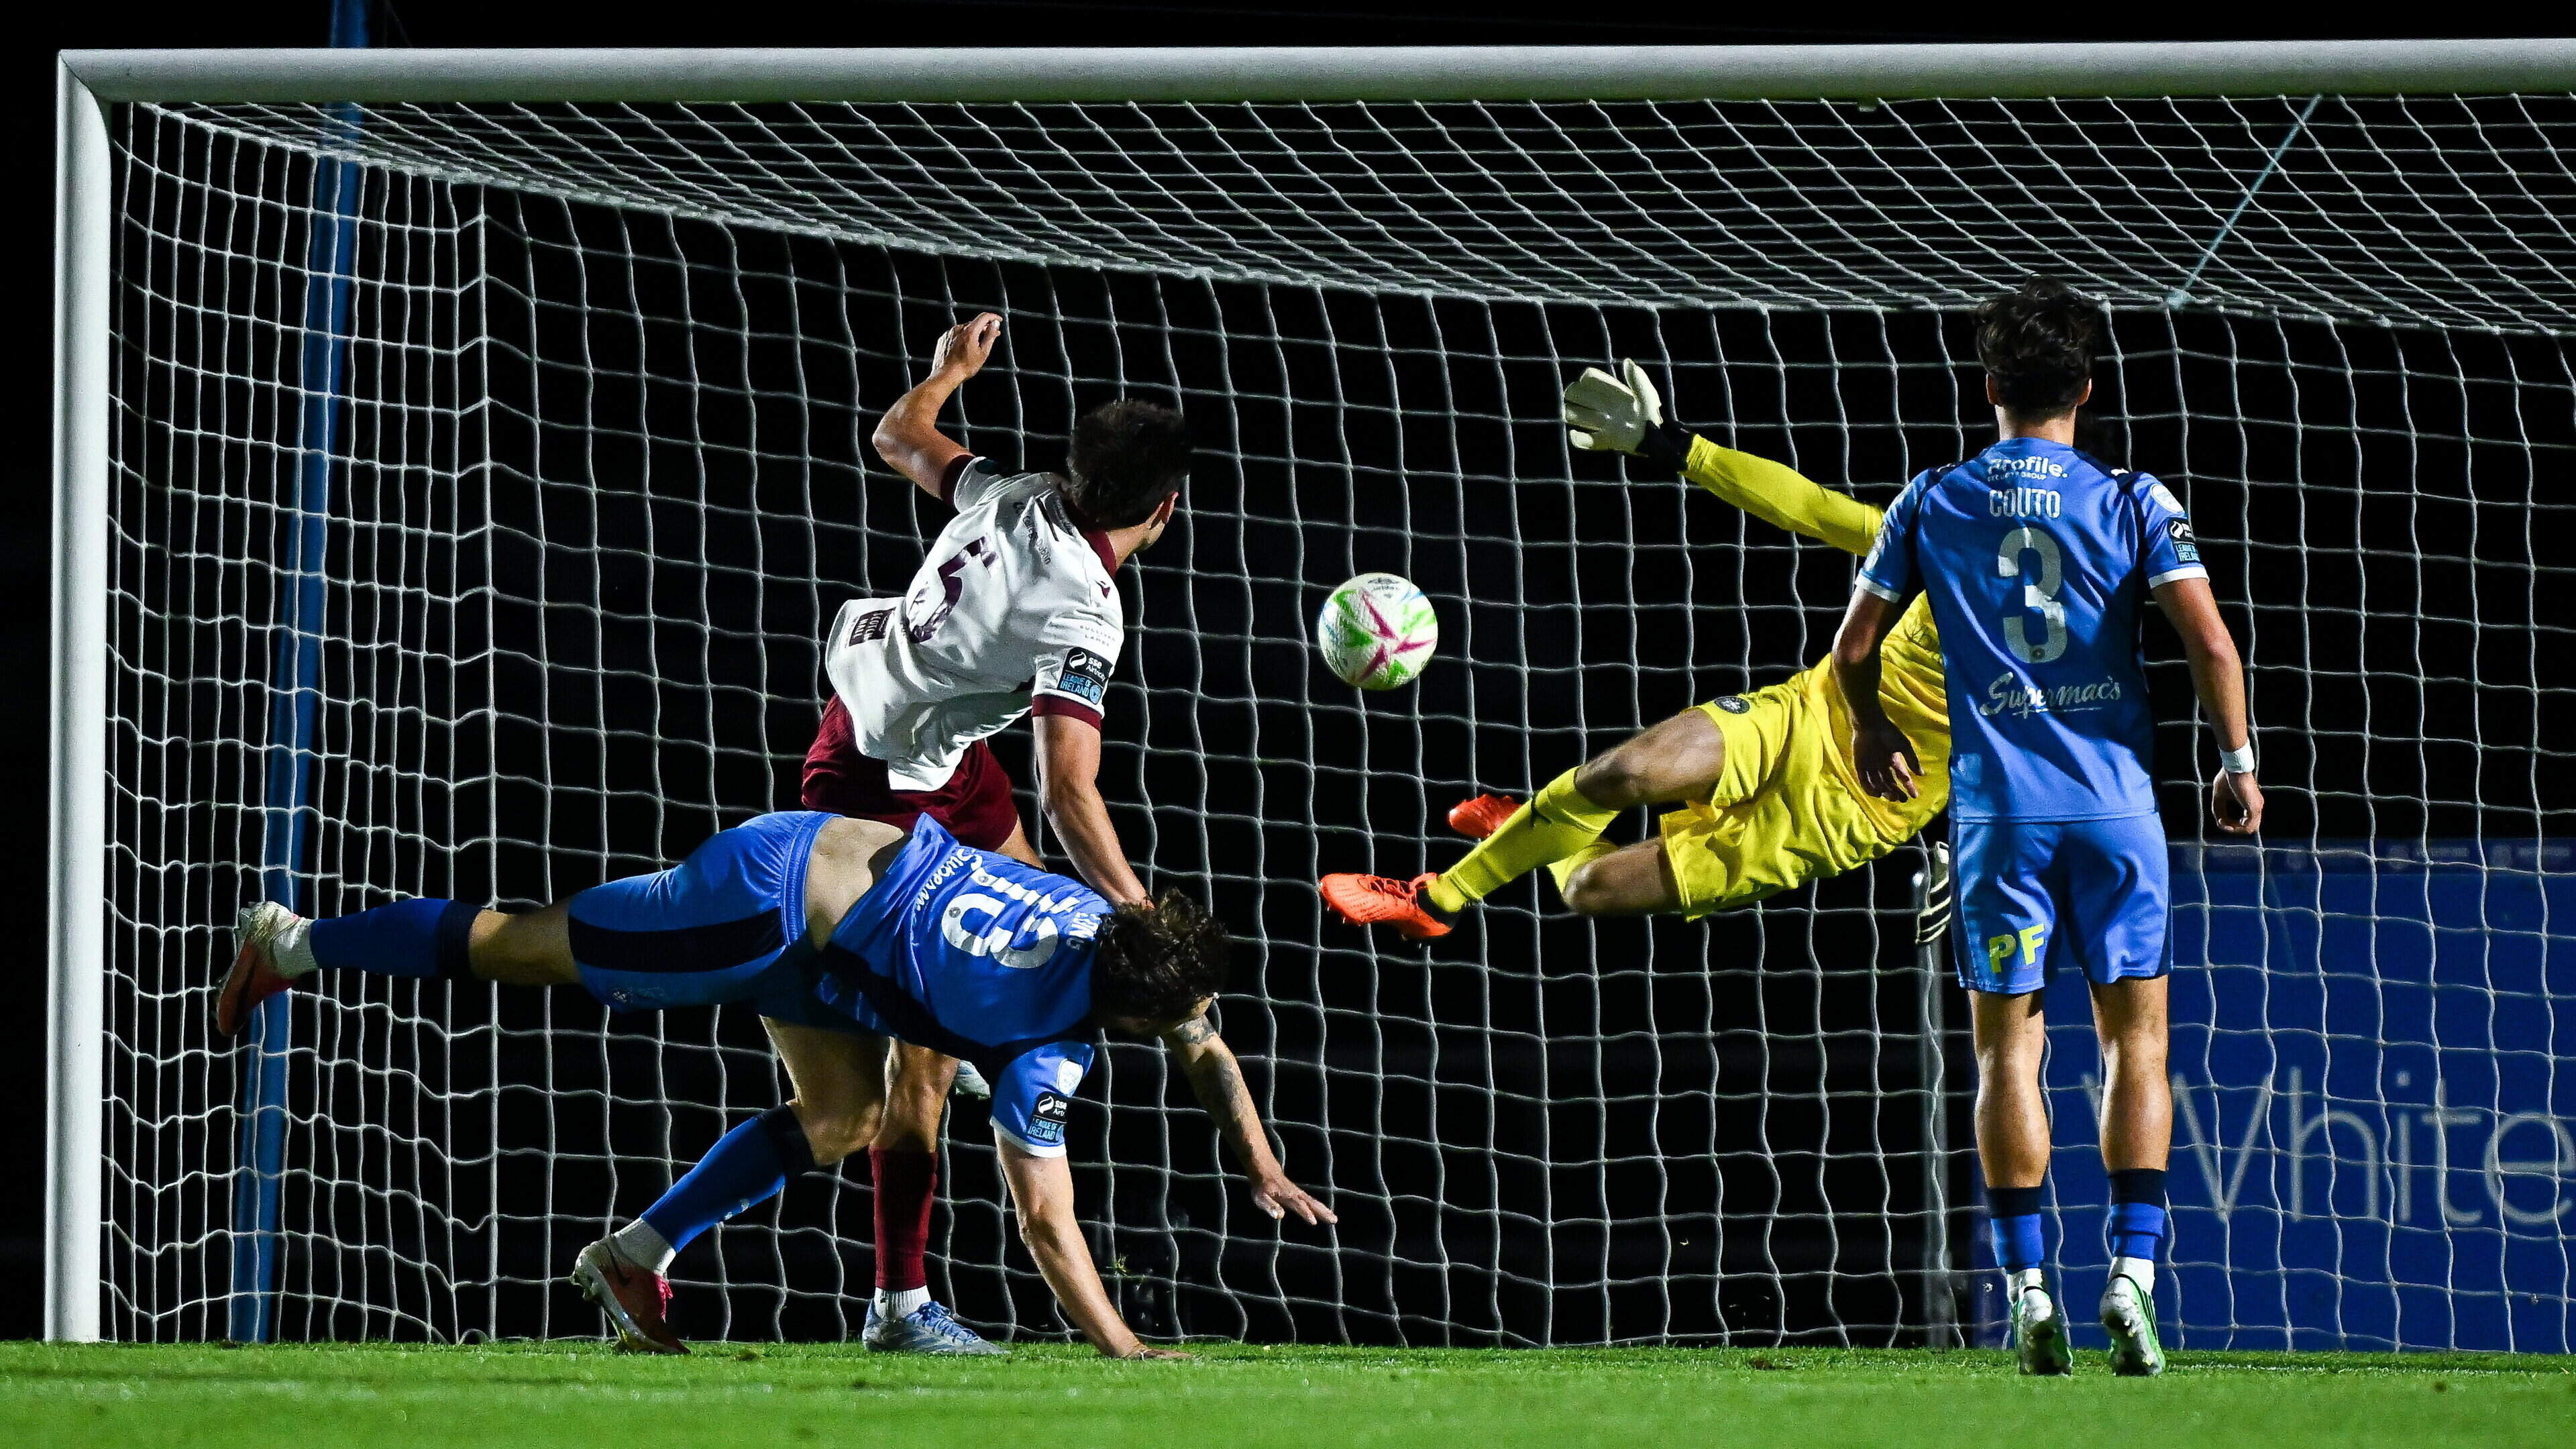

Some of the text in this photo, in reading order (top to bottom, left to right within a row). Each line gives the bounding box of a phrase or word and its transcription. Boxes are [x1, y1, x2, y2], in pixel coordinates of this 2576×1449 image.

[1989, 486, 2061, 519] COUTO
[1998, 527, 2068, 663] 3
[1087, 657, 1103, 669] sse
[1060, 680, 1090, 698] IRELAND
[1063, 673, 1093, 687] LEAGUE OF
[1979, 672, 2121, 719] Supermac's
[1988, 922, 2045, 974] PF
[1027, 1125, 1057, 1140] IRELAND
[2082, 1066, 2576, 1224] White
